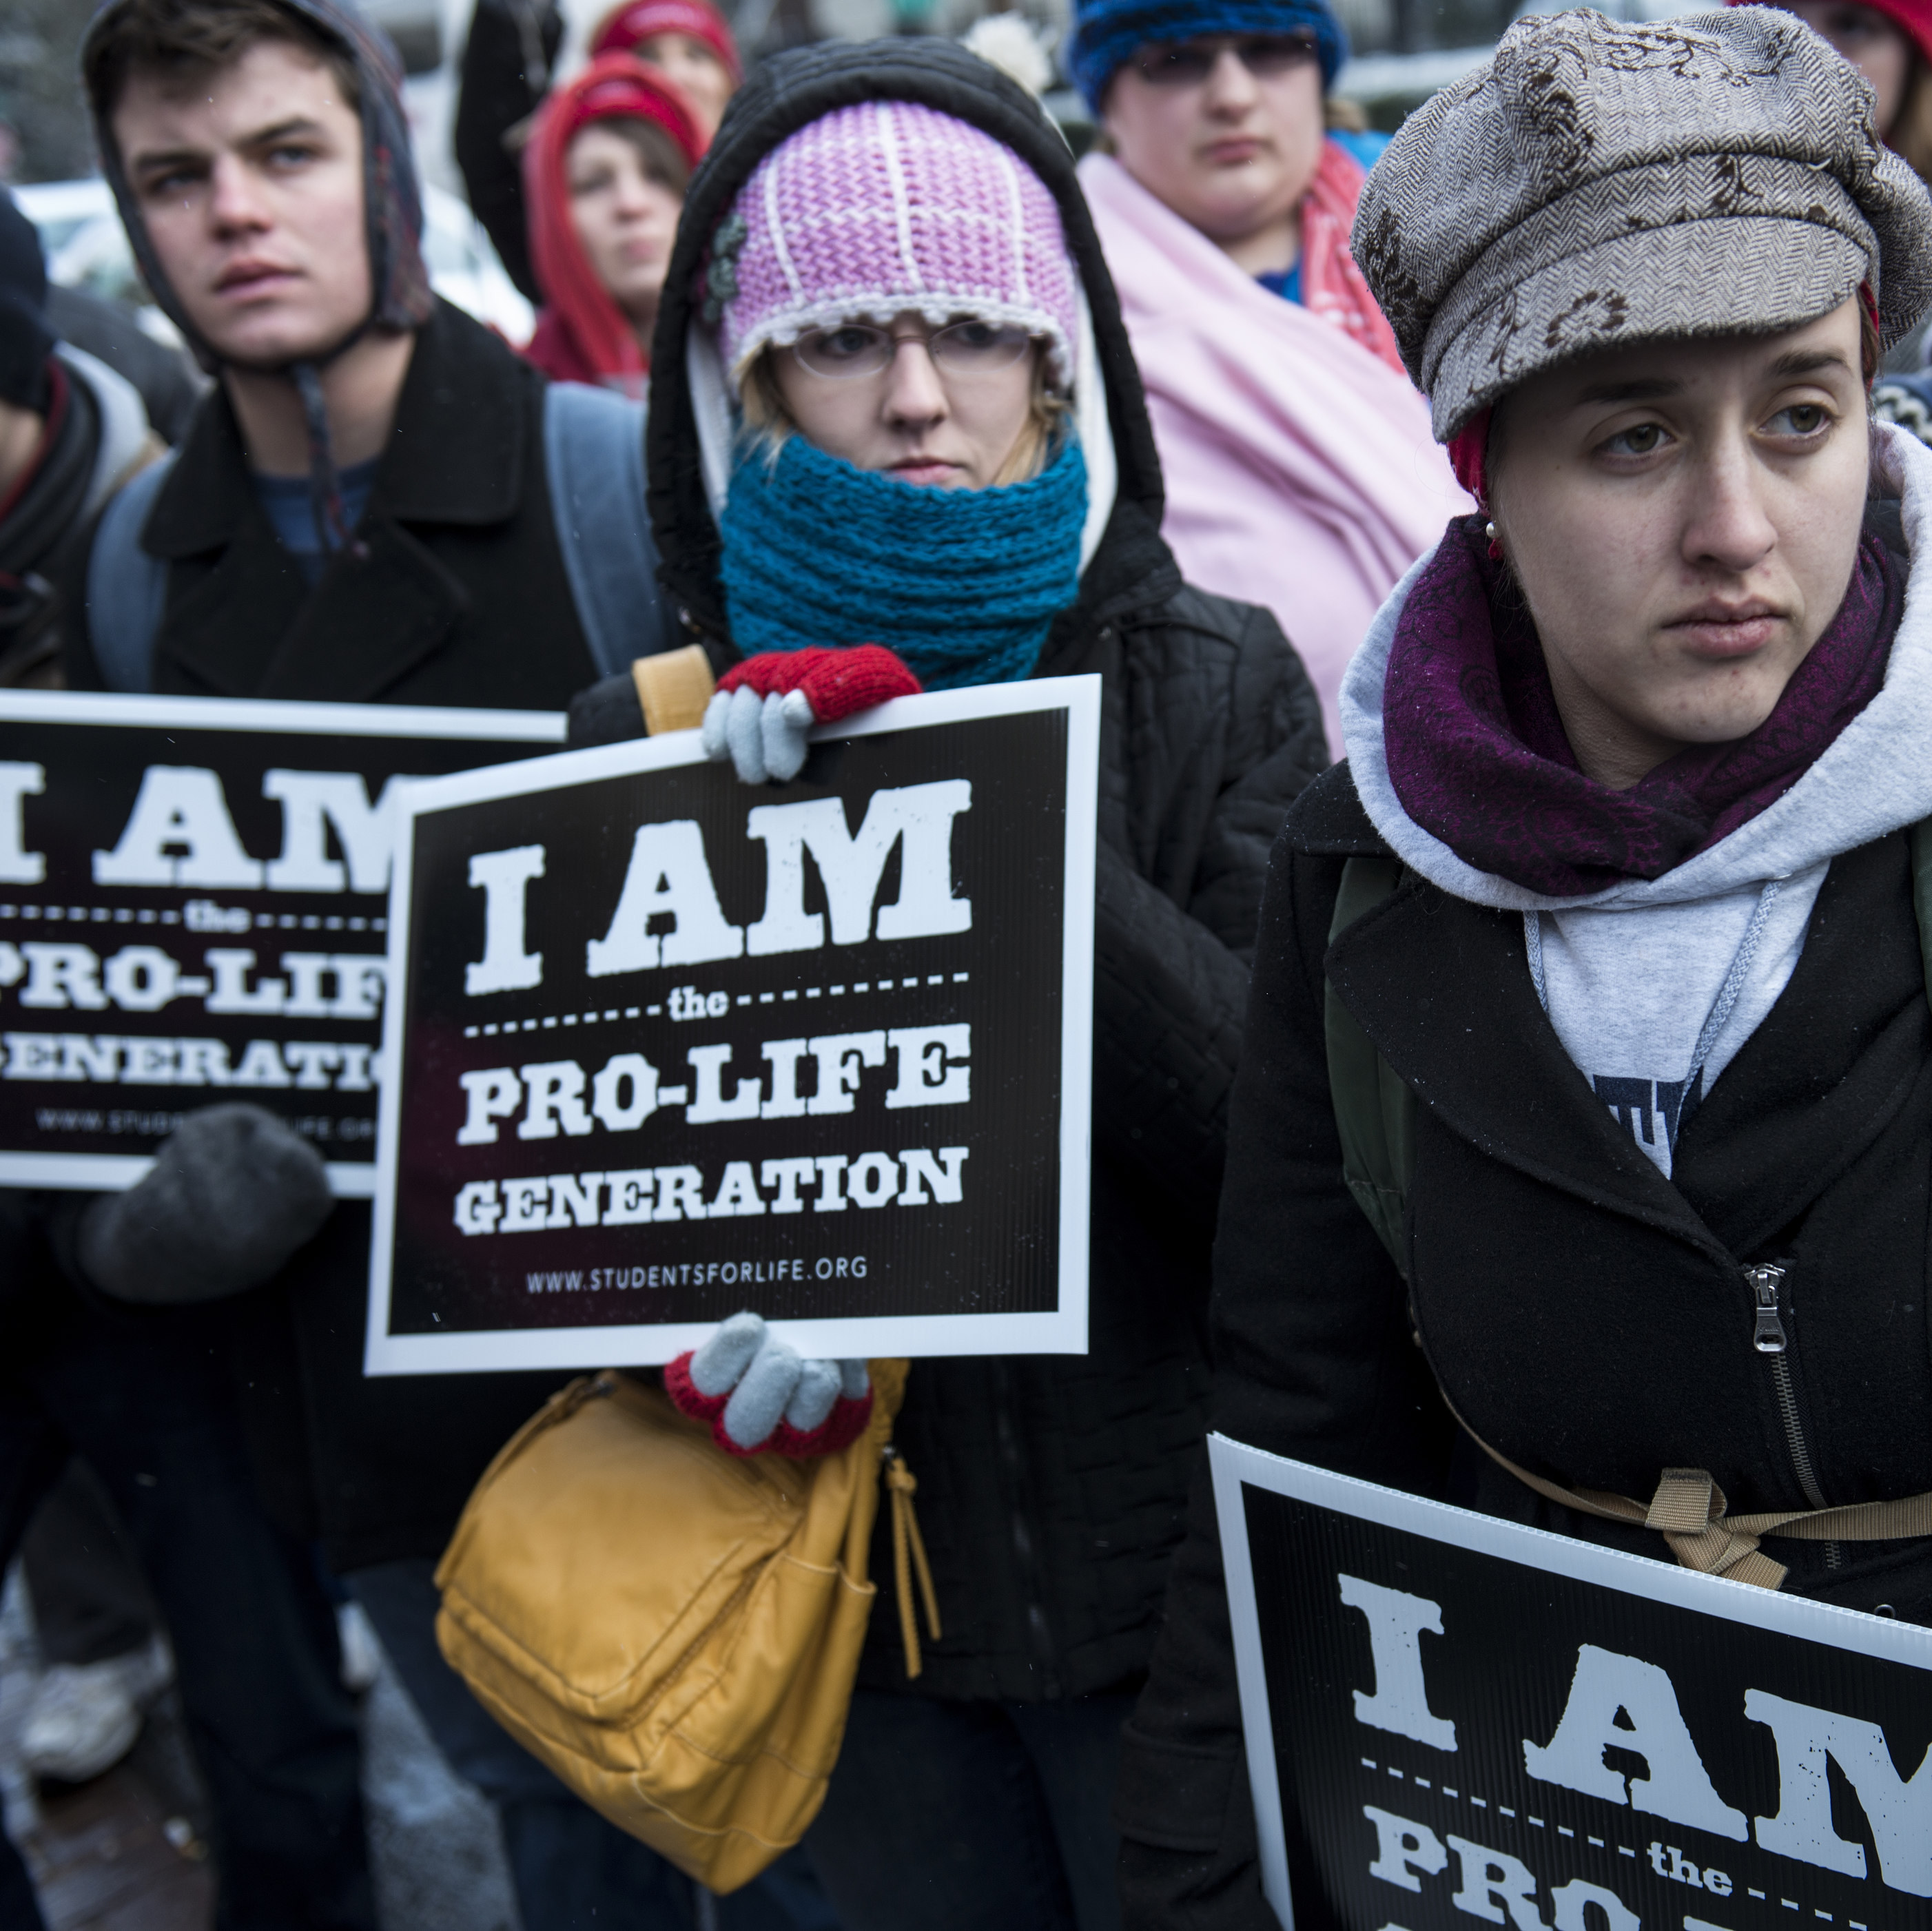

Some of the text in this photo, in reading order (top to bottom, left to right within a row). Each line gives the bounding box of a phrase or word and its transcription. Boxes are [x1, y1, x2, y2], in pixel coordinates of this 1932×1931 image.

[465, 778, 972, 995] I AM
[183, 900, 251, 933] the
[668, 986, 729, 1022] the
[0, 1033, 383, 1091] ENERATI
[458, 1023, 971, 1145] PRO-LIFE
[454, 1146, 969, 1236] GENERATION
[526, 1255, 867, 1294] WWW.STUDENTSFORLIFE.ORG
[1338, 1573, 1932, 1898] I AM
[1647, 1841, 1733, 1897] the
